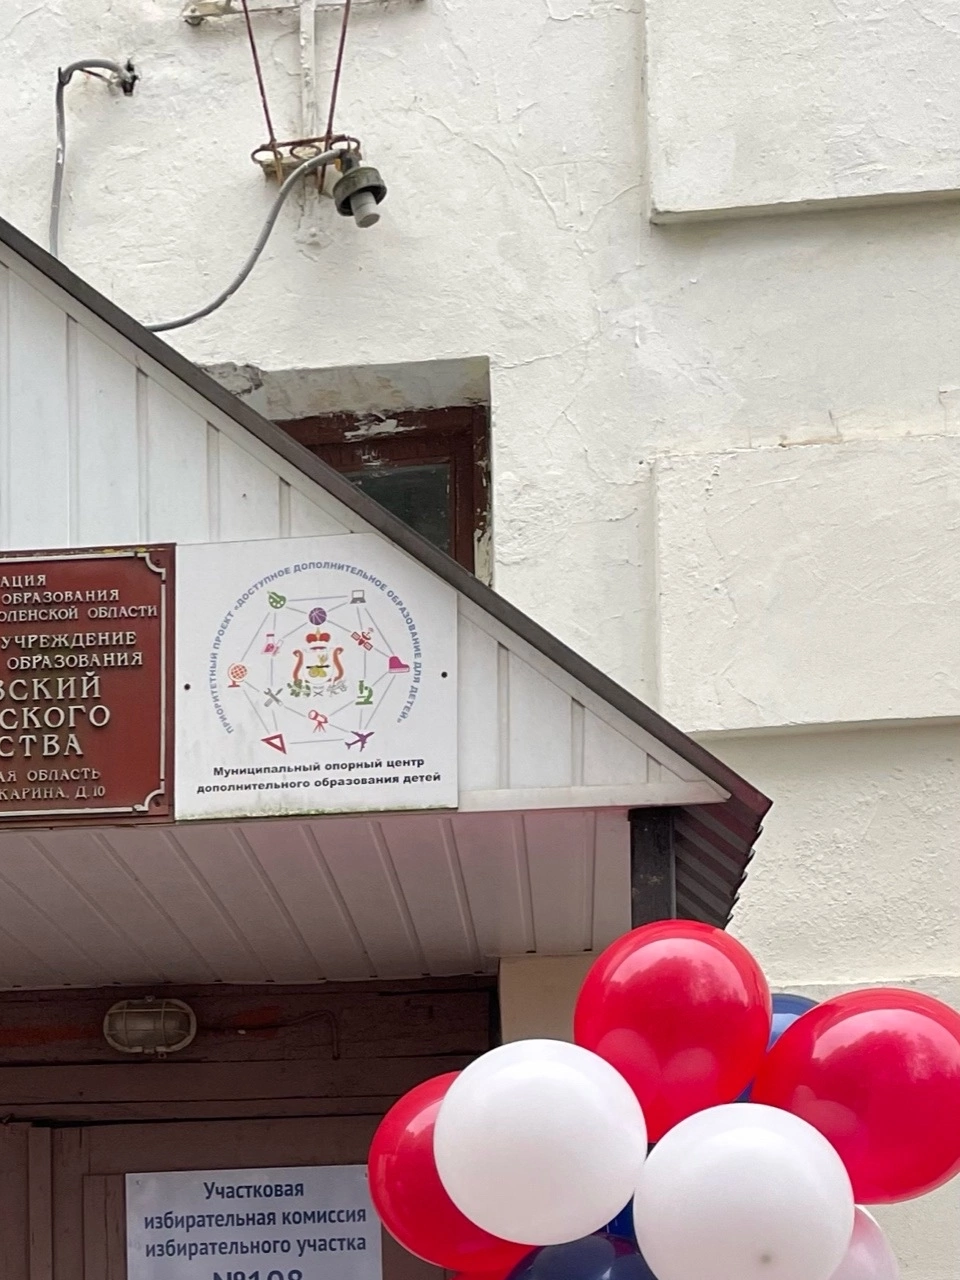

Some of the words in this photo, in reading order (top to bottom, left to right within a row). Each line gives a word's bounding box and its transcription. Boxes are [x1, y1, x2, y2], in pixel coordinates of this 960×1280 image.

[293, 562, 387, 591] ДОПОЛНИТЕЛЬНОЕ
[2, 589, 120, 604] ОБРАЗОВАНИЯ
[234, 567, 291, 611] «ДОСТУПНОЕ
[88, 605, 157, 619] ОБЛАСТИ
[213, 611, 234, 649] ПРОЕКТ
[387, 590, 421, 658] ОБРАЗОВАНИЕ
[1, 632, 136, 650] УЧРЕЖДЕНИЕ
[7, 652, 143, 670] ОБРАЗОВАНИЯ
[413, 662, 422, 683] ДЛЯ
[209, 653, 234, 734] ПРИОРИТЕТНЫЙ
[27, 768, 100, 782] ОБЛАСТЬ
[214, 762, 320, 777] Муниципальный
[325, 759, 382, 772] опорный
[387, 758, 425, 770] центр
[197, 779, 310, 793] дополнительного
[314, 776, 399, 788] образования
[403, 773, 441, 784] детей
[204, 1182, 304, 1199] Участковая
[144, 1211, 275, 1232] избирательная
[282, 1208, 366, 1225] комиссия
[146, 1239, 291, 1260] избирательного
[297, 1236, 366, 1256] участка
